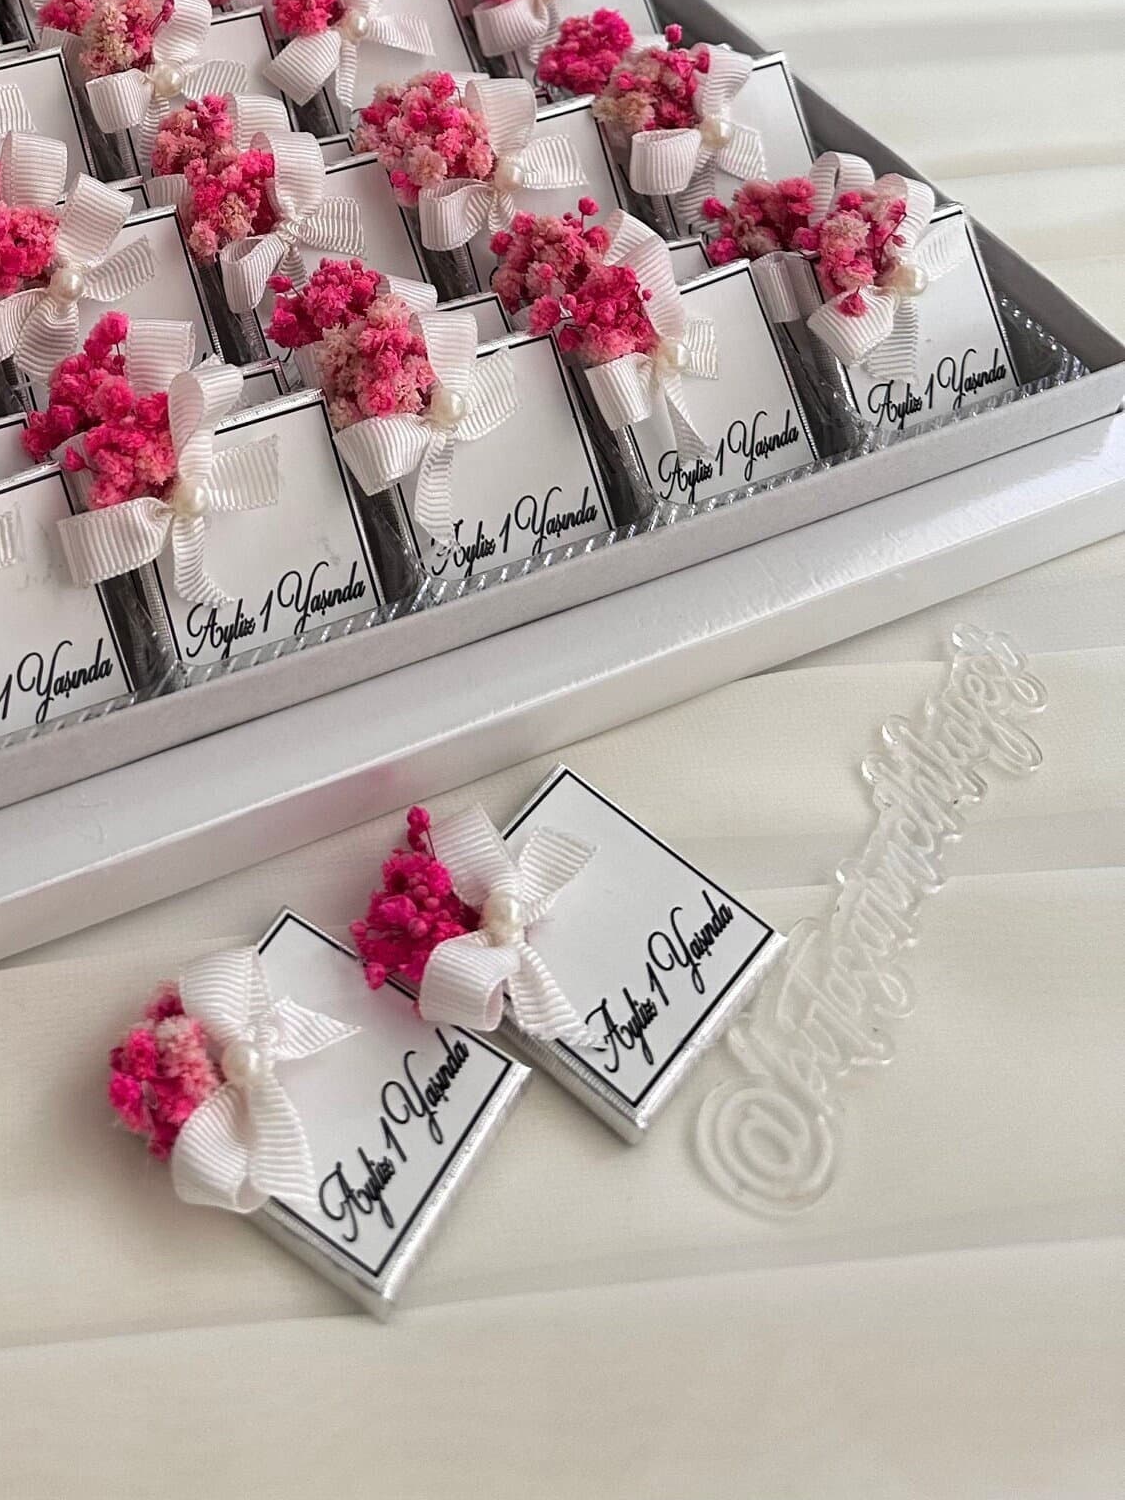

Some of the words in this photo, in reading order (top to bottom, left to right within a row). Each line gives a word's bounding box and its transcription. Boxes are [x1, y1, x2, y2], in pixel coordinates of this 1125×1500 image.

[924, 372, 935, 410] 1
[714, 437, 725, 477] 1
[498, 512, 512, 554] 1
[259, 588, 274, 633] 1
[276, 560, 367, 636] Yaşında
[16, 637, 114, 725] Yaşında
[645, 960, 670, 1007] 1
[379, 1115, 408, 1163] 1
